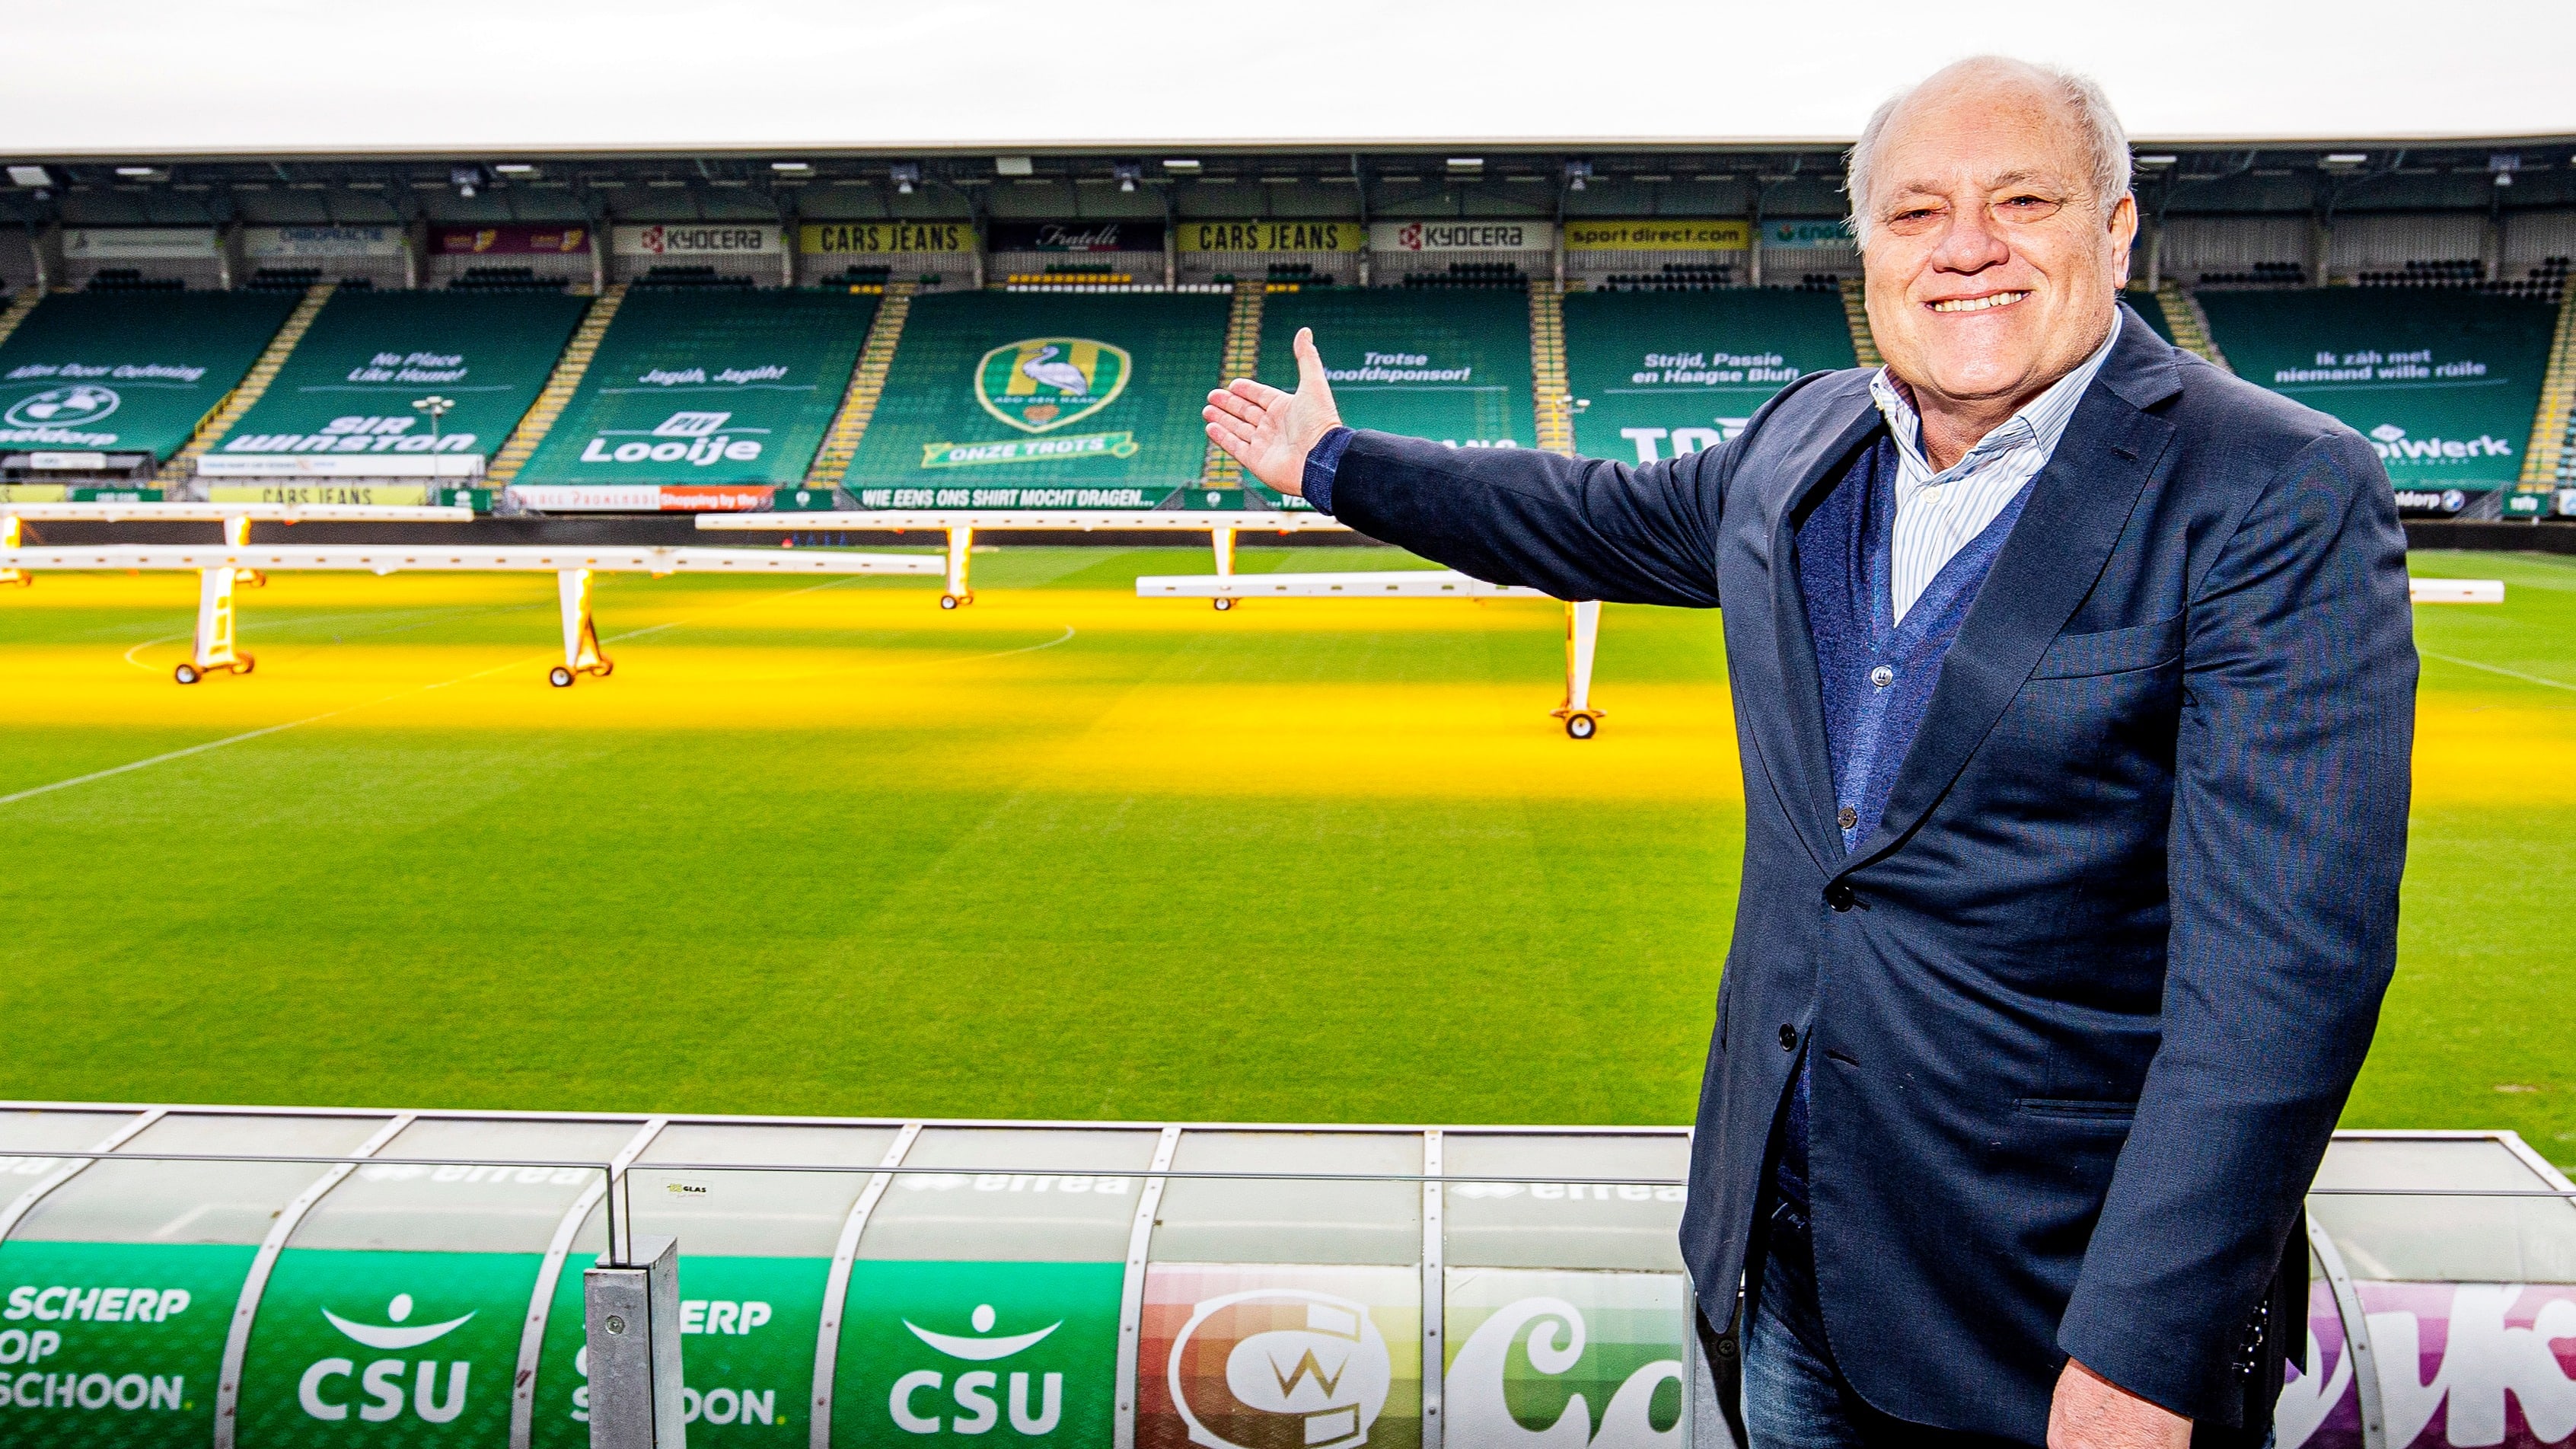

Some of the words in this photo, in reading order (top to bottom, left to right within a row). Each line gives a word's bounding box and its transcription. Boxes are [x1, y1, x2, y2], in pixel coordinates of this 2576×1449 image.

[821, 226, 880, 251] CARS
[888, 226, 960, 251] JEANS
[1199, 225, 1259, 251] CARS
[1267, 225, 1338, 251] JEANS
[1364, 352, 1428, 366] Trotse
[1644, 353, 1707, 371] Strijd,
[1713, 353, 1784, 368] Passie
[2315, 351, 2337, 366] Ik
[2387, 349, 2431, 364] met
[1632, 369, 1659, 384] en
[1664, 369, 1743, 385] Haagse
[2275, 365, 2372, 383] niemand
[320, 416, 416, 435] SIR
[580, 436, 762, 466] Looije
[949, 443, 1016, 461] ONZE
[1024, 437, 1105, 455] TROTS
[862, 490, 891, 507] WIE
[894, 490, 934, 507] EENS
[938, 490, 970, 507] ONS
[973, 490, 1021, 507] SHIRT
[1024, 490, 1077, 507] MOCHT
[3, 1286, 190, 1323] SCHERP
[0, 1329, 61, 1364] OP
[298, 1361, 470, 1424] CSU
[889, 1371, 1063, 1435] CSU
